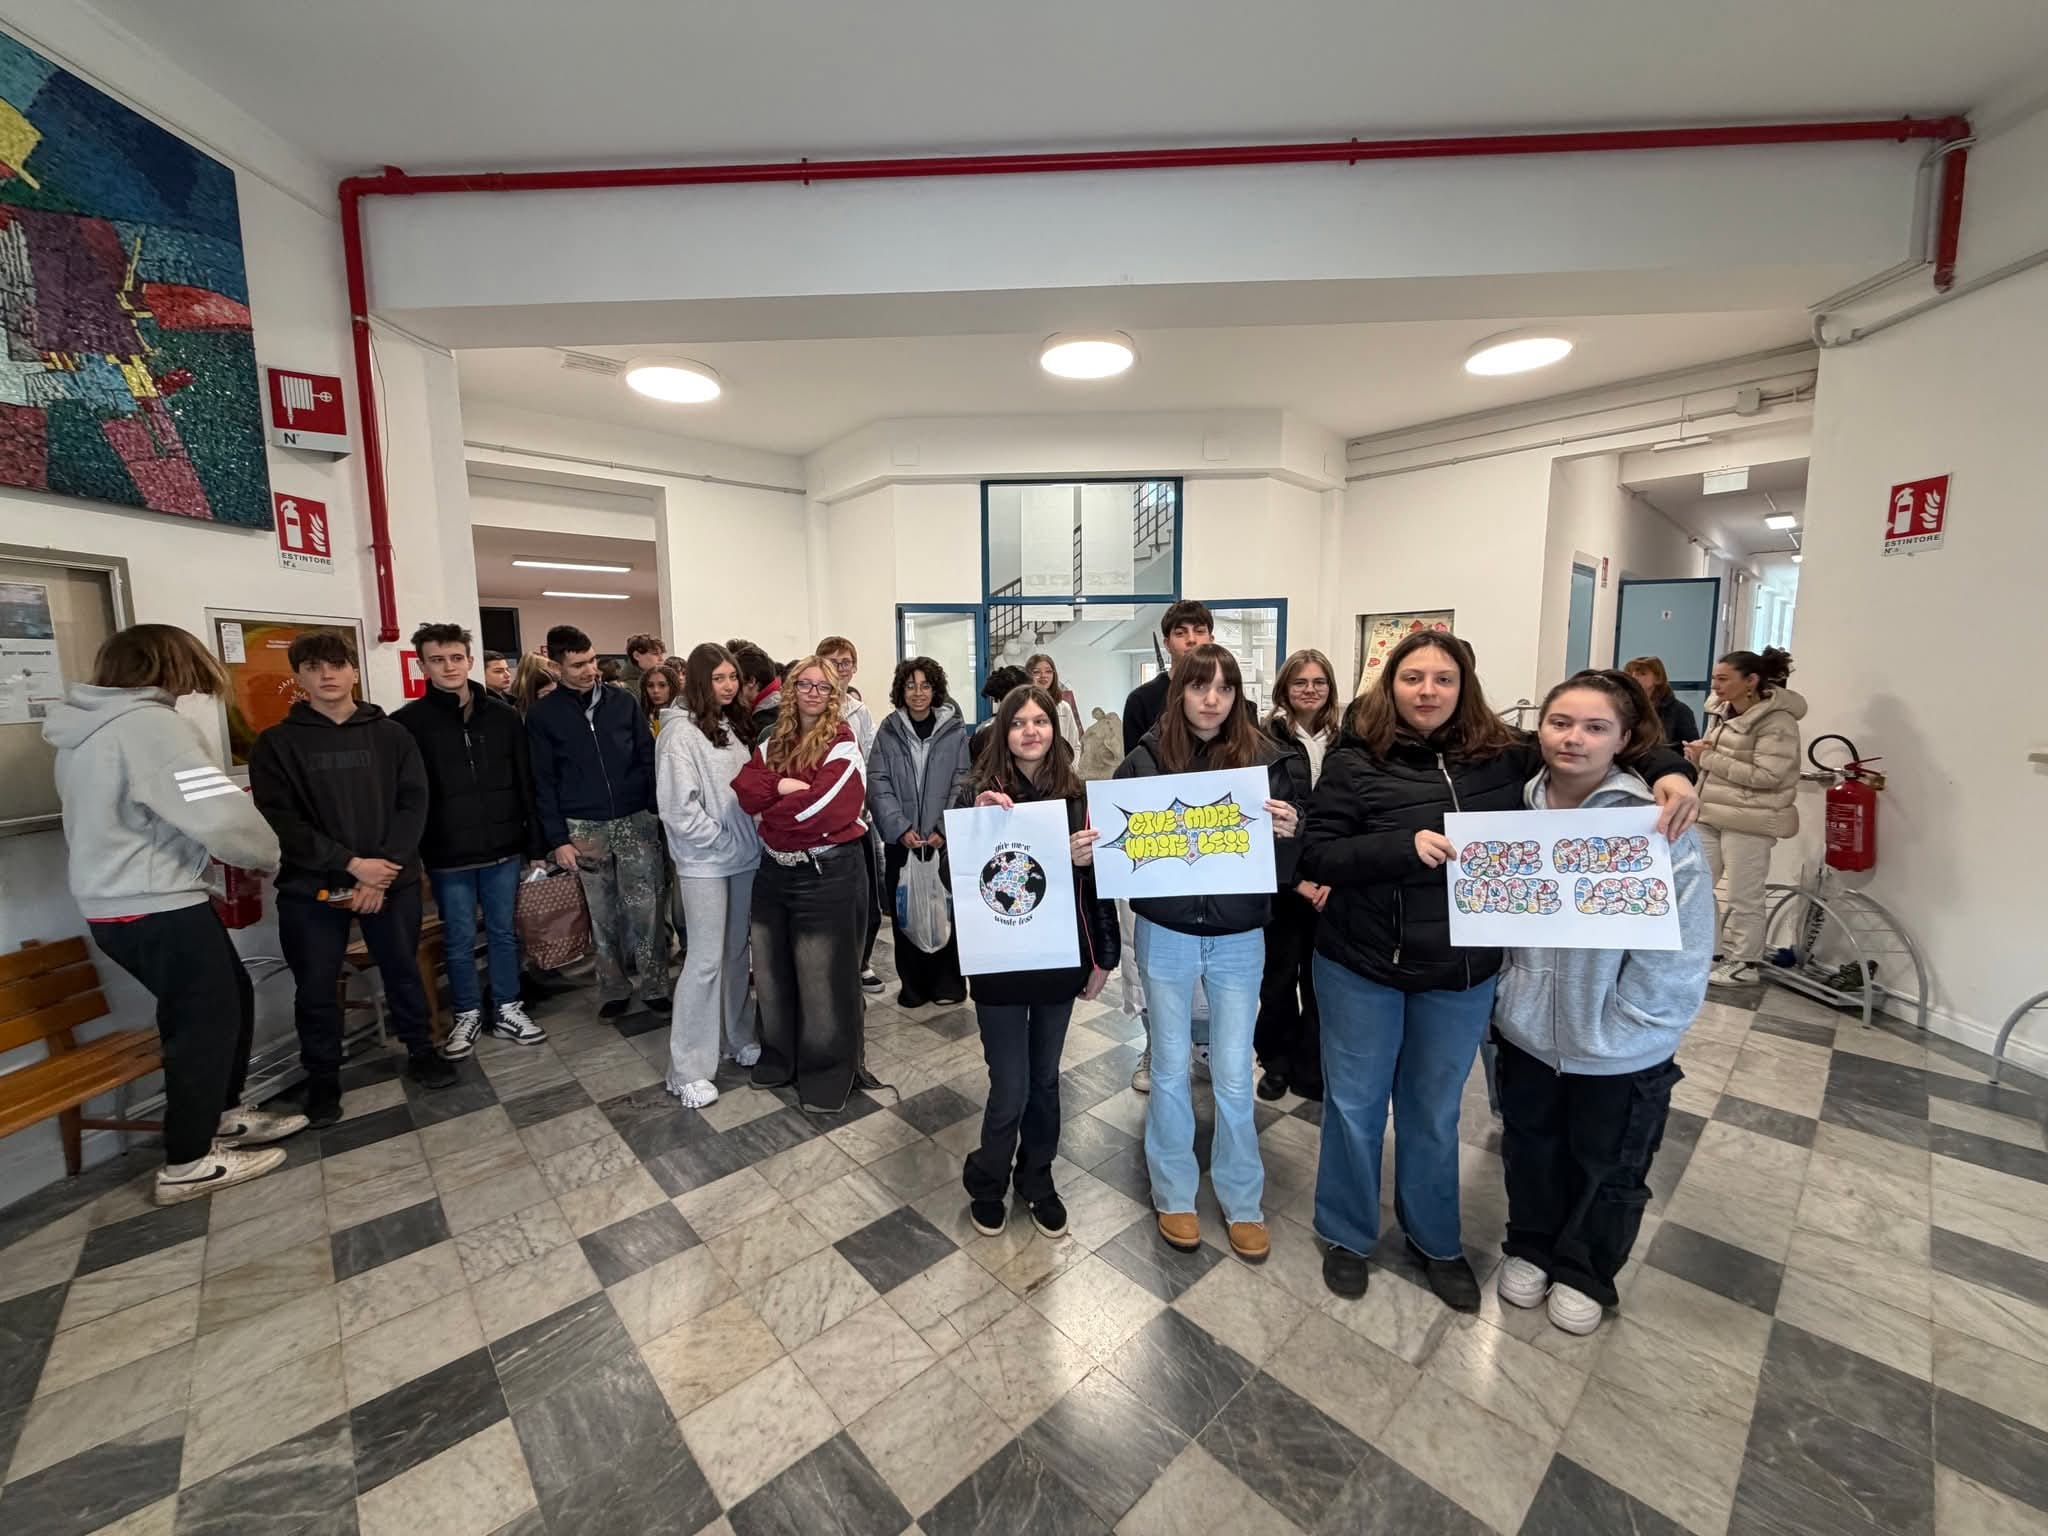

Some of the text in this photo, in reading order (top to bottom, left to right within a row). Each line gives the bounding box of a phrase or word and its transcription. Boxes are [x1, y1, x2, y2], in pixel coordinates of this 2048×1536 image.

[1884, 535, 1940, 548] ESTINTORE
[281, 552, 332, 566] ESTINTORE
[1128, 803, 1242, 835] GIVE MORE
[1125, 829, 1250, 859] WASTE LESS
[1460, 836, 1653, 878] GIVE MORE
[1454, 877, 1670, 916] WASTE LESS
